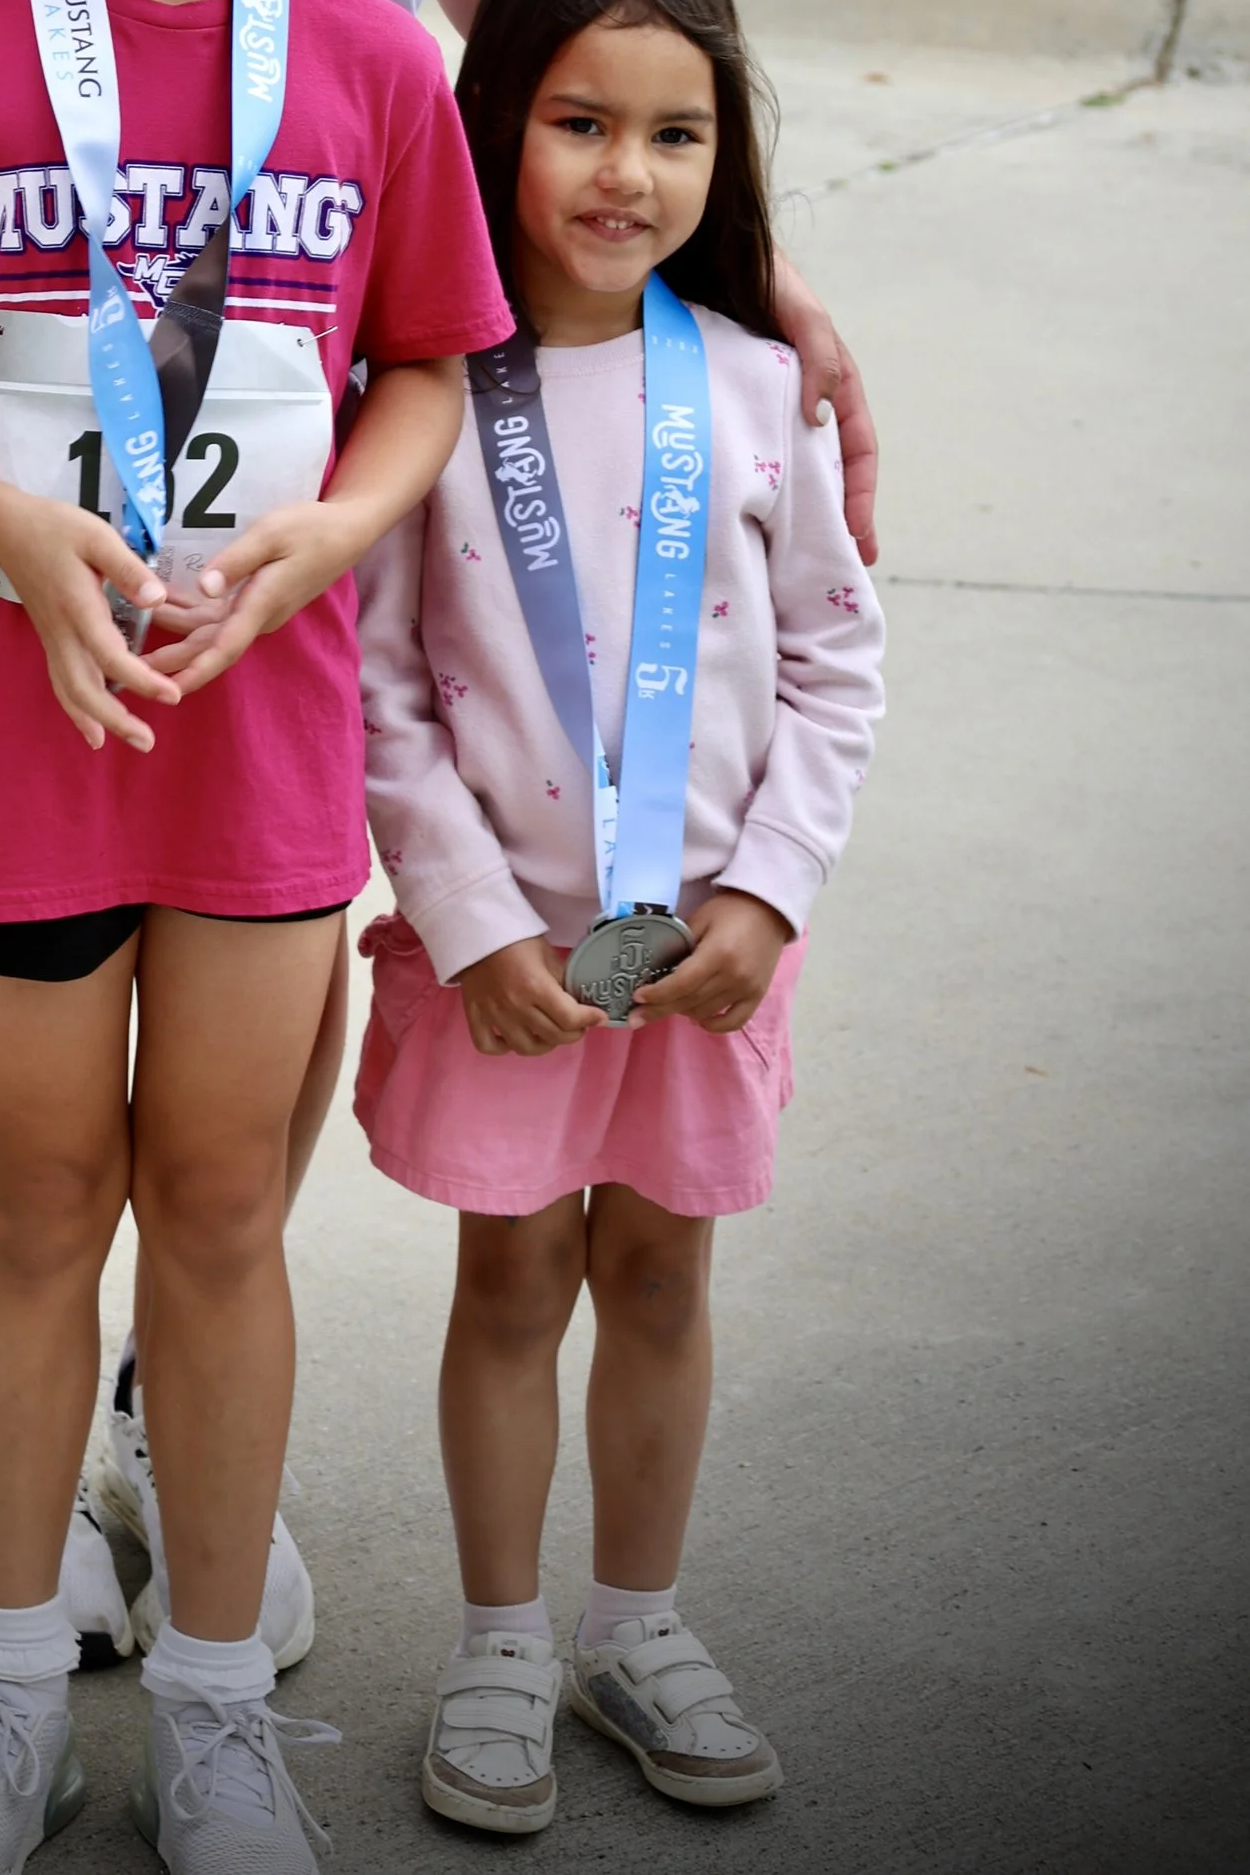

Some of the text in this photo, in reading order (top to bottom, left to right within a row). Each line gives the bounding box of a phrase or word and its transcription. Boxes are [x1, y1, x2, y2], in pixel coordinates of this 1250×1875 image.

[68, 431, 240, 528] 12
[493, 351, 560, 571] MUSTANG LAKE
[651, 404, 703, 560] MUSTANG
[659, 573, 676, 648] LAKES
